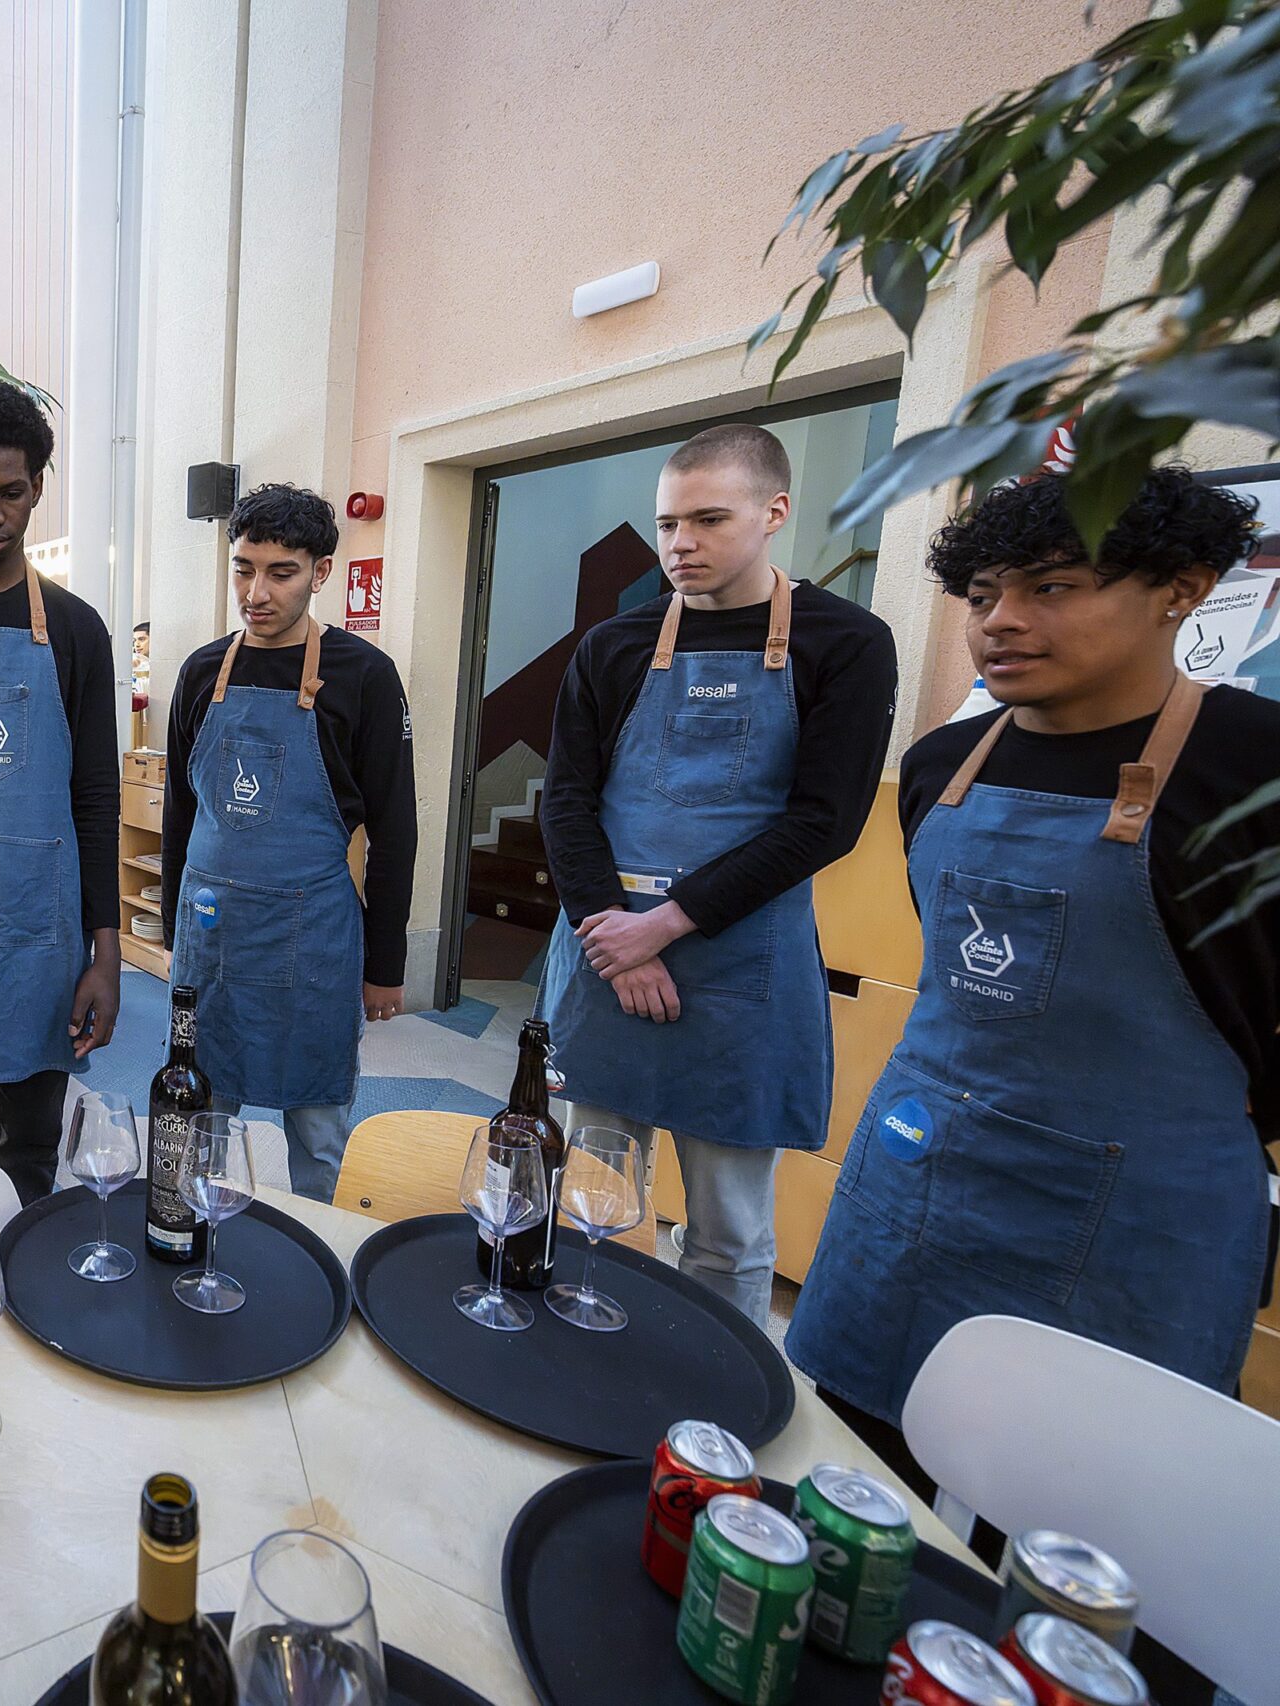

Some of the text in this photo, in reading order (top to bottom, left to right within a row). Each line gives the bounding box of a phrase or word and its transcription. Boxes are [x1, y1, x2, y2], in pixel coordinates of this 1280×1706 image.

[1200, 592, 1252, 607] envenidos
[688, 683, 727, 698] cesal
[233, 805, 259, 816] MADRID
[194, 902, 210, 915] cesal
[969, 941, 1004, 956] Quinta
[981, 936, 995, 947] La
[967, 950, 1002, 965] Cocina
[963, 980, 1014, 1002] MADRID
[885, 1115, 916, 1141] cesal
